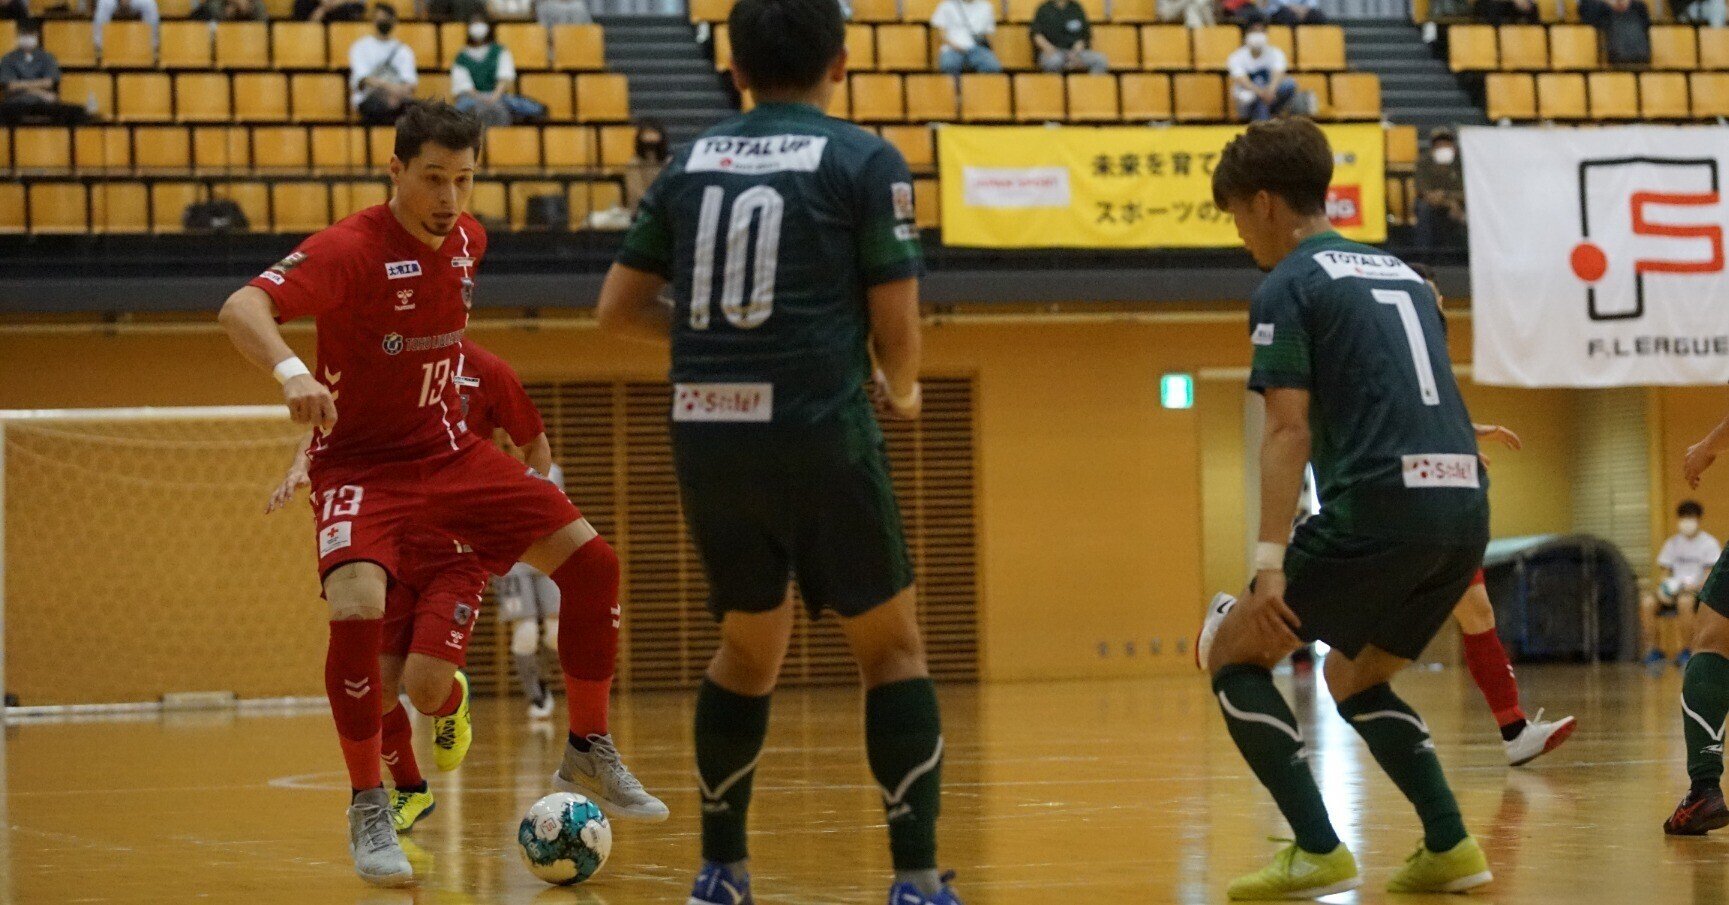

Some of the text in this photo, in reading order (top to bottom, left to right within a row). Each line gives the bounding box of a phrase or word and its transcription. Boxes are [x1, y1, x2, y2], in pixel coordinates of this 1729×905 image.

[702, 136, 812, 156] TOTAL UP
[1096, 201, 1234, 224] スポーツの
[690, 185, 784, 329] 10
[1325, 252, 1381, 267] TOTAL
[418, 358, 451, 408] 13
[322, 484, 365, 522] 13
